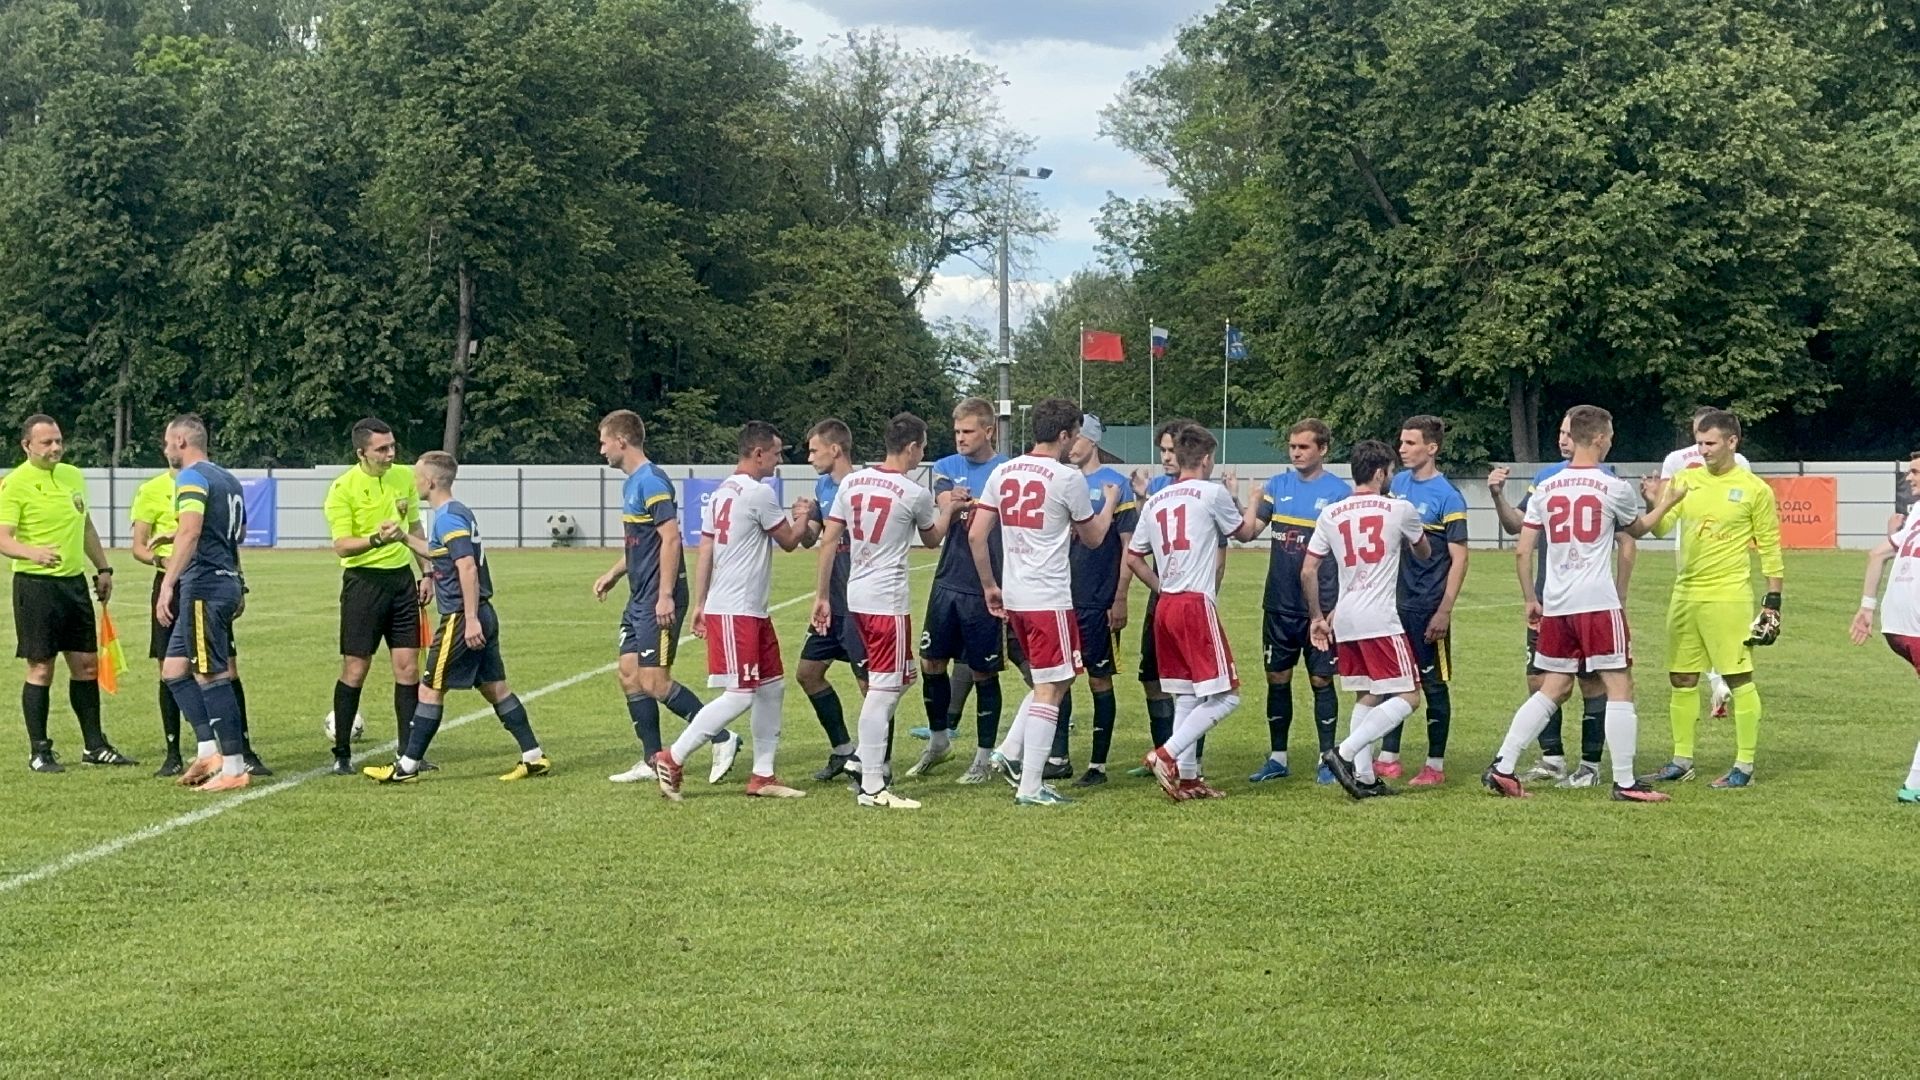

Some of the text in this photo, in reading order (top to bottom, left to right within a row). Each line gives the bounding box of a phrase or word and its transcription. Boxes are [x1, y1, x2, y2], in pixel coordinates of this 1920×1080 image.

[227, 493, 244, 541] 10
[850, 493, 893, 545] 17
[1000, 478, 1046, 530] 22
[1546, 494, 1603, 544] 20
[1155, 504, 1191, 557] 11
[1338, 515, 1386, 568] 13
[743, 663, 760, 682] 14
